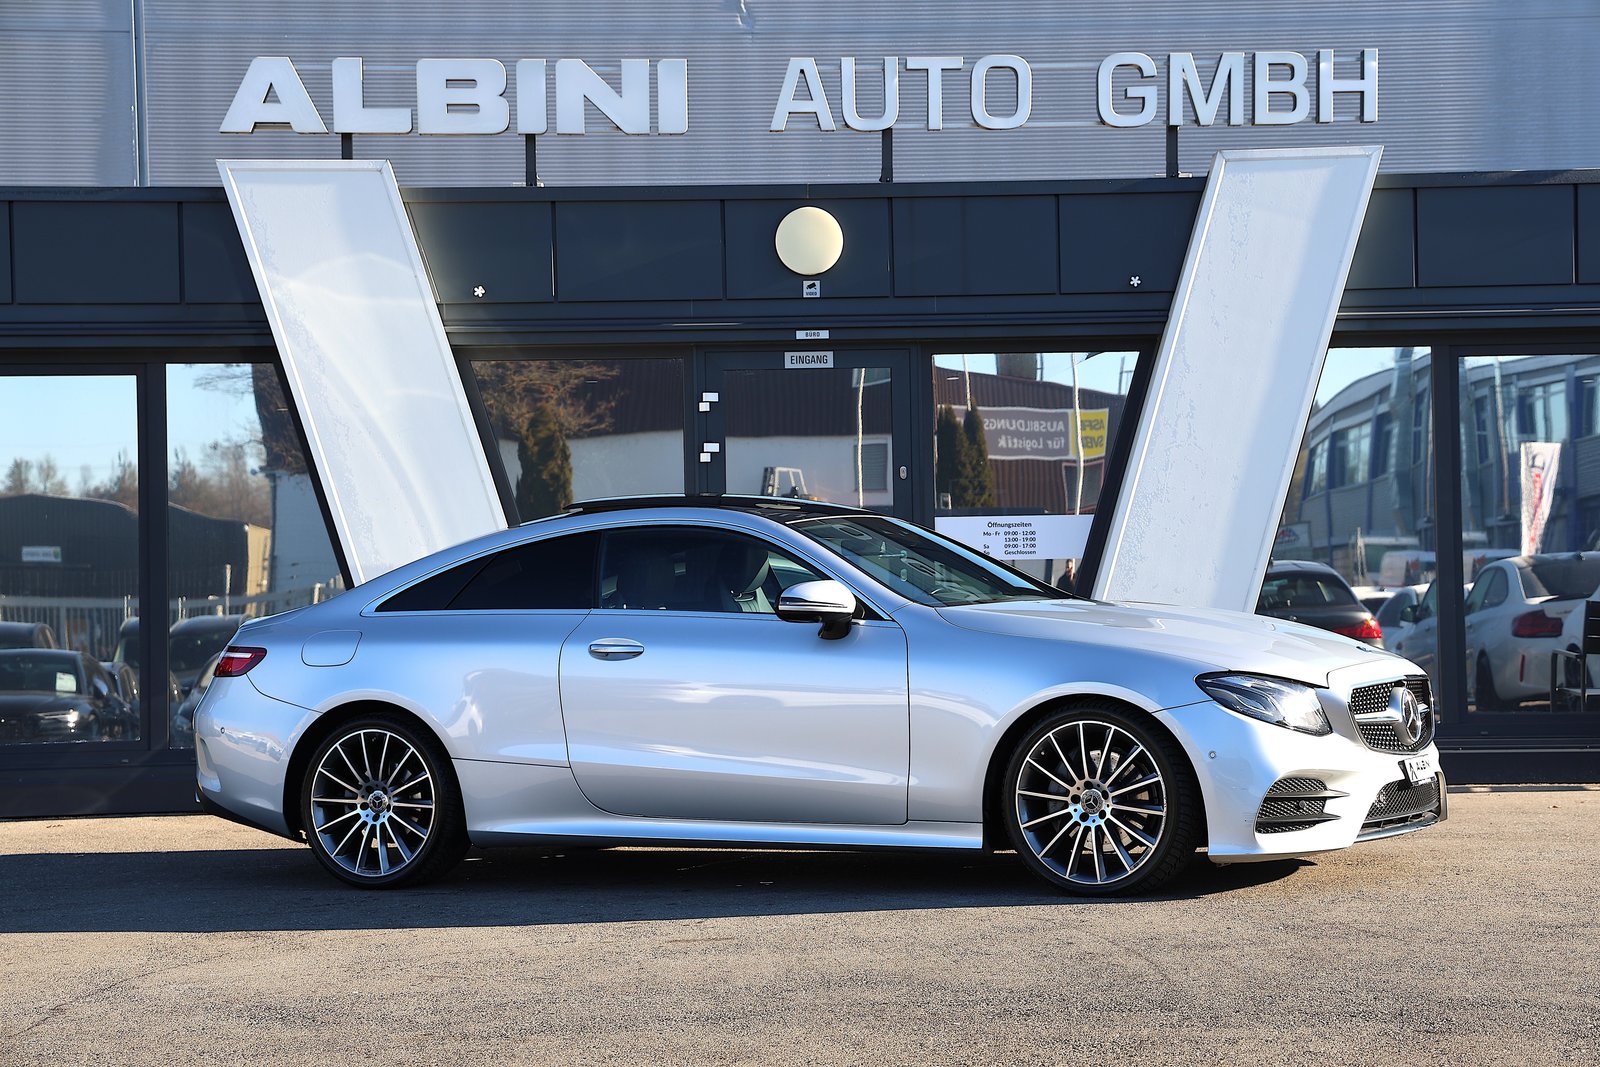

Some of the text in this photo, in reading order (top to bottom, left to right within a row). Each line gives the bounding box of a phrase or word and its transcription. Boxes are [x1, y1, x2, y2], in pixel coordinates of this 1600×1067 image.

[219, 48, 1380, 135] ALBINI AUTO GMBH
[790, 354, 828, 365] EINGANG
